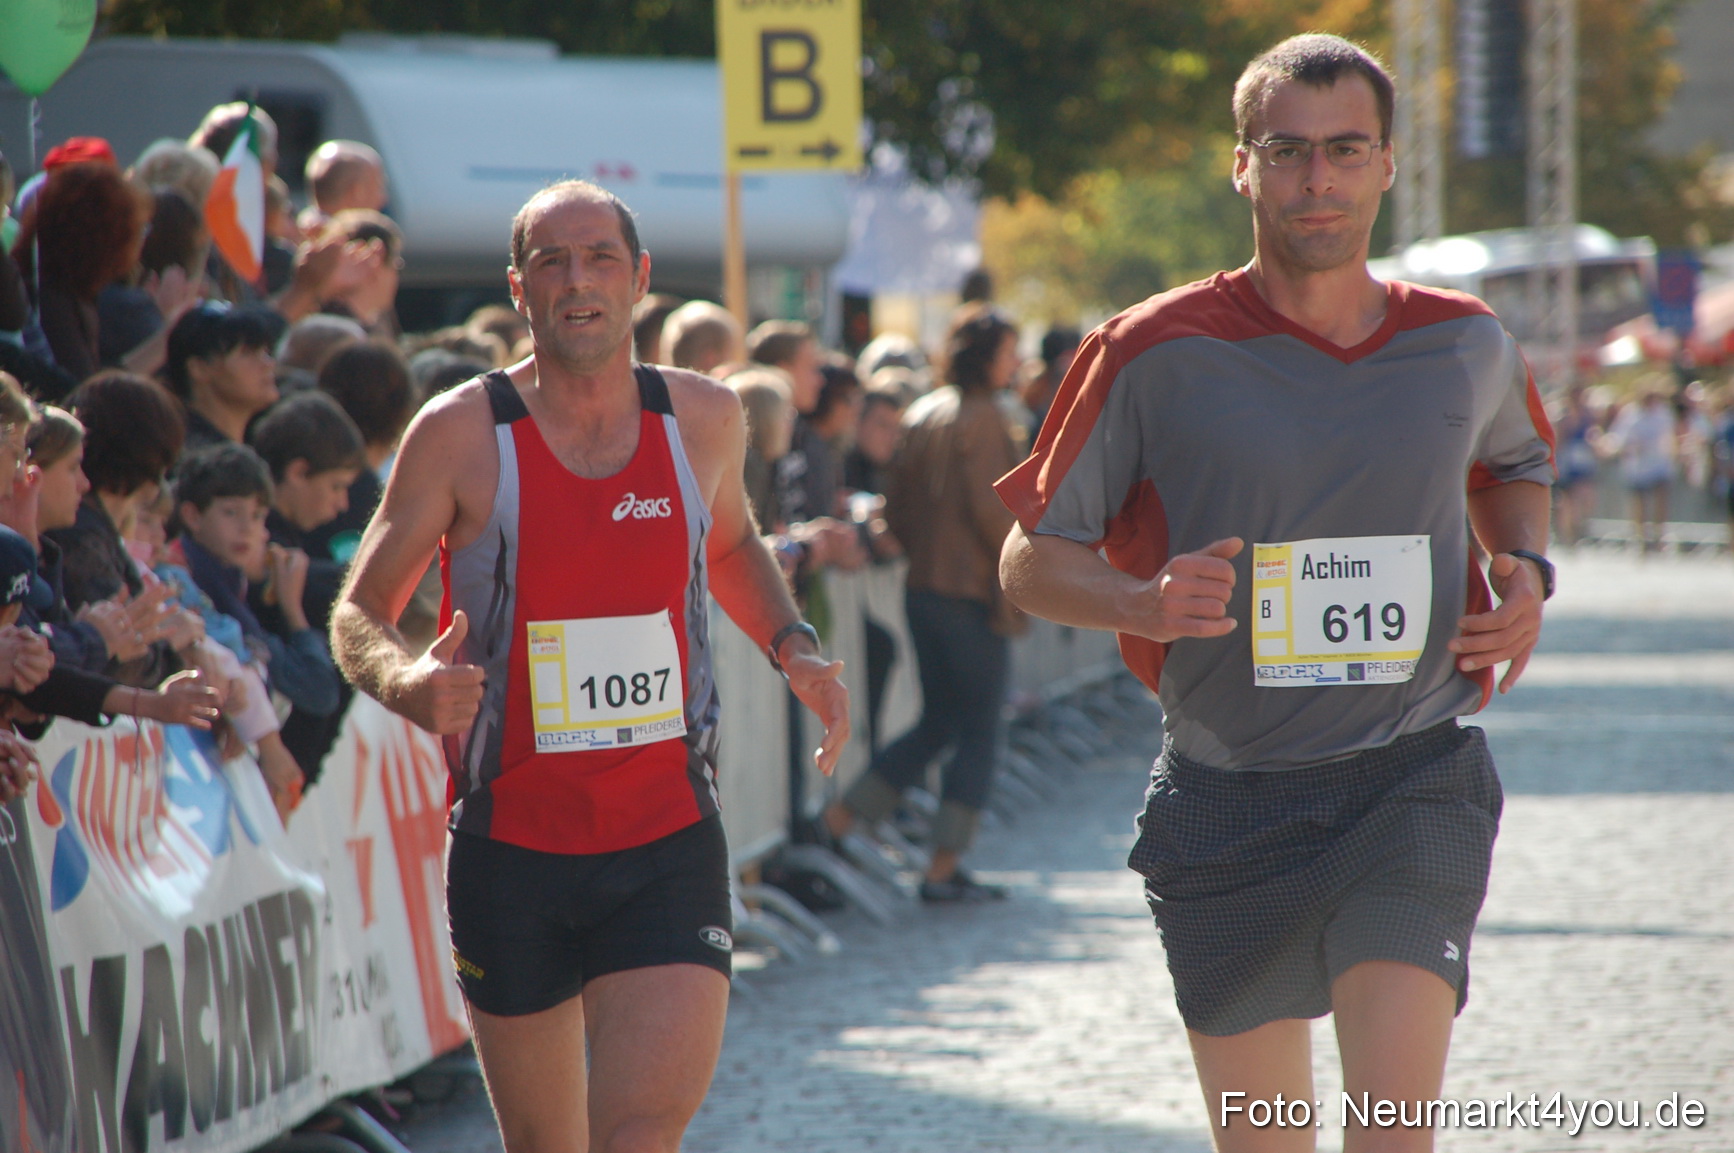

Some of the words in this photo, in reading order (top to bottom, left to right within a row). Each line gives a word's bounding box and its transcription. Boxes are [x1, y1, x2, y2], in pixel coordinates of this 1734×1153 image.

[760, 30, 822, 122] B
[1301, 552, 1371, 580] Achim
[1262, 600, 1271, 618] B
[1322, 602, 1406, 643] 619
[580, 668, 670, 709] 1087
[634, 717, 682, 735] PFLEIDERER
